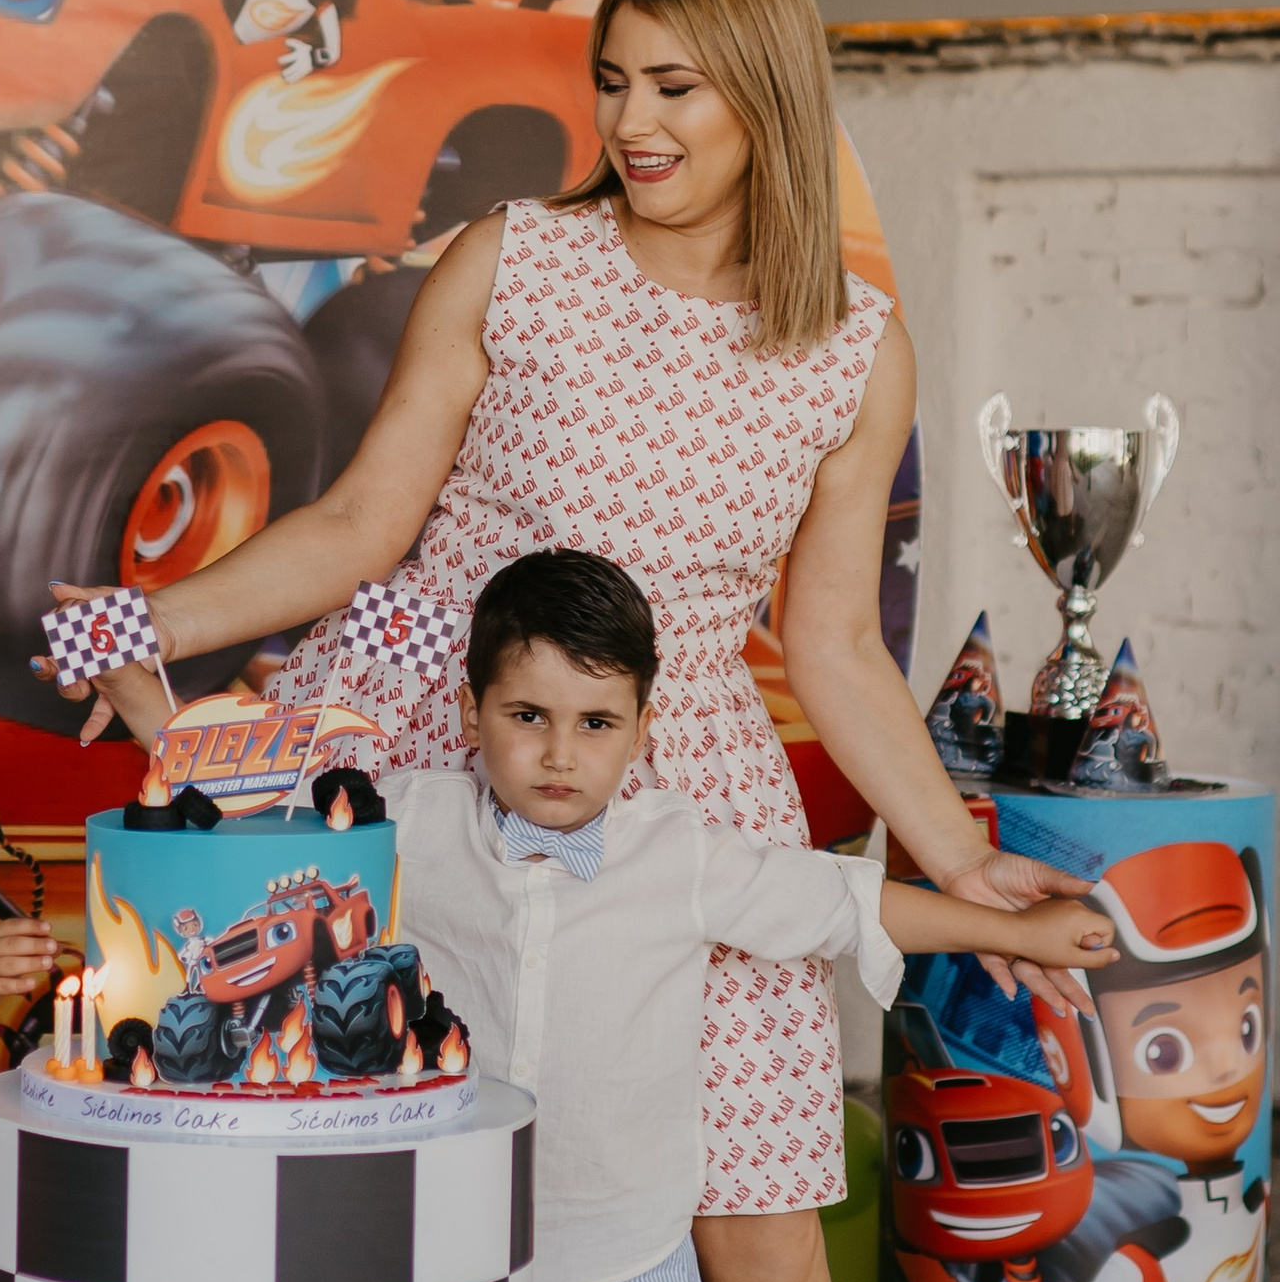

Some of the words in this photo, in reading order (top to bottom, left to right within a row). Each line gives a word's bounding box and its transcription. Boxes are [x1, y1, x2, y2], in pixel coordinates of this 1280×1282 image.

[90, 613, 116, 654] 5
[383, 611, 414, 645] 5
[162, 716, 319, 784] BLAZE
[241, 772, 299, 790] MACHINES
